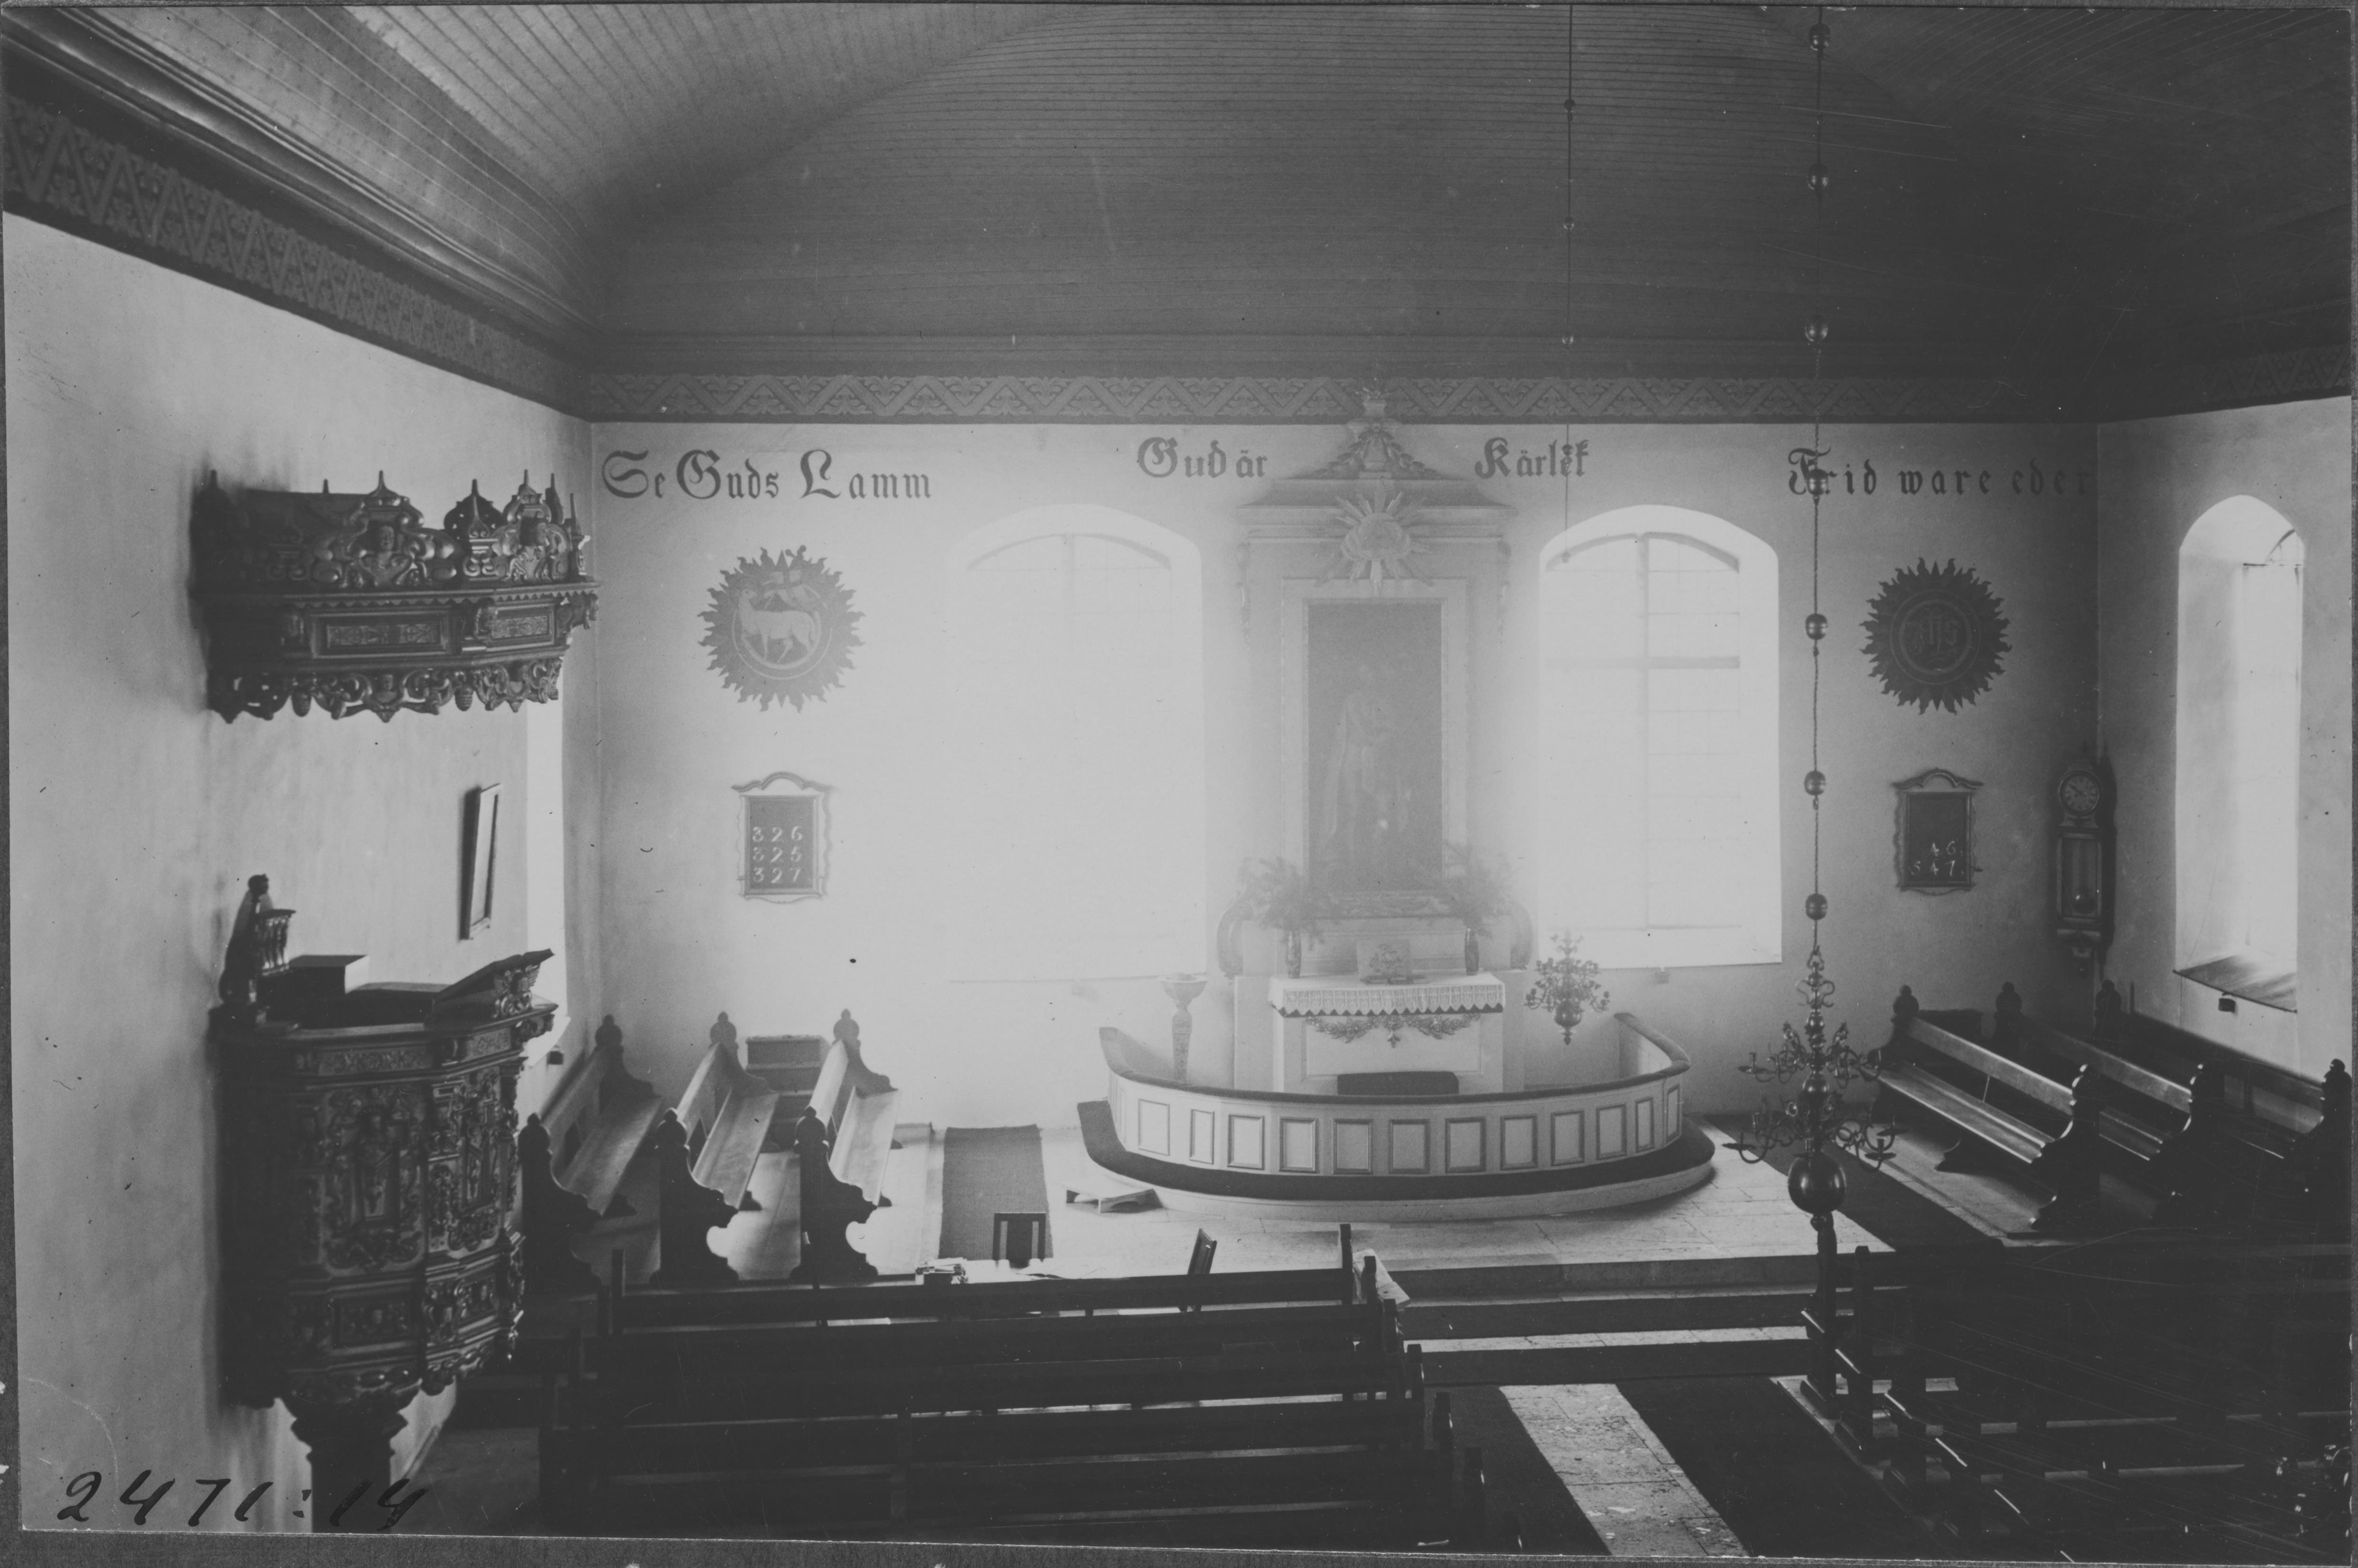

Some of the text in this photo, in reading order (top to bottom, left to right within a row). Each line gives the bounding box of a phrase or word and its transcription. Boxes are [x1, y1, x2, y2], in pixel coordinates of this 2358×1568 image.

[602, 448, 932, 500] Se Guds Lamm
[1138, 436, 1590, 480] Gud är Kärlek
[1897, 469, 1992, 495] ware
[2012, 458, 2094, 496] eder
[752, 825, 803, 842] 326
[752, 866, 800, 884] 327
